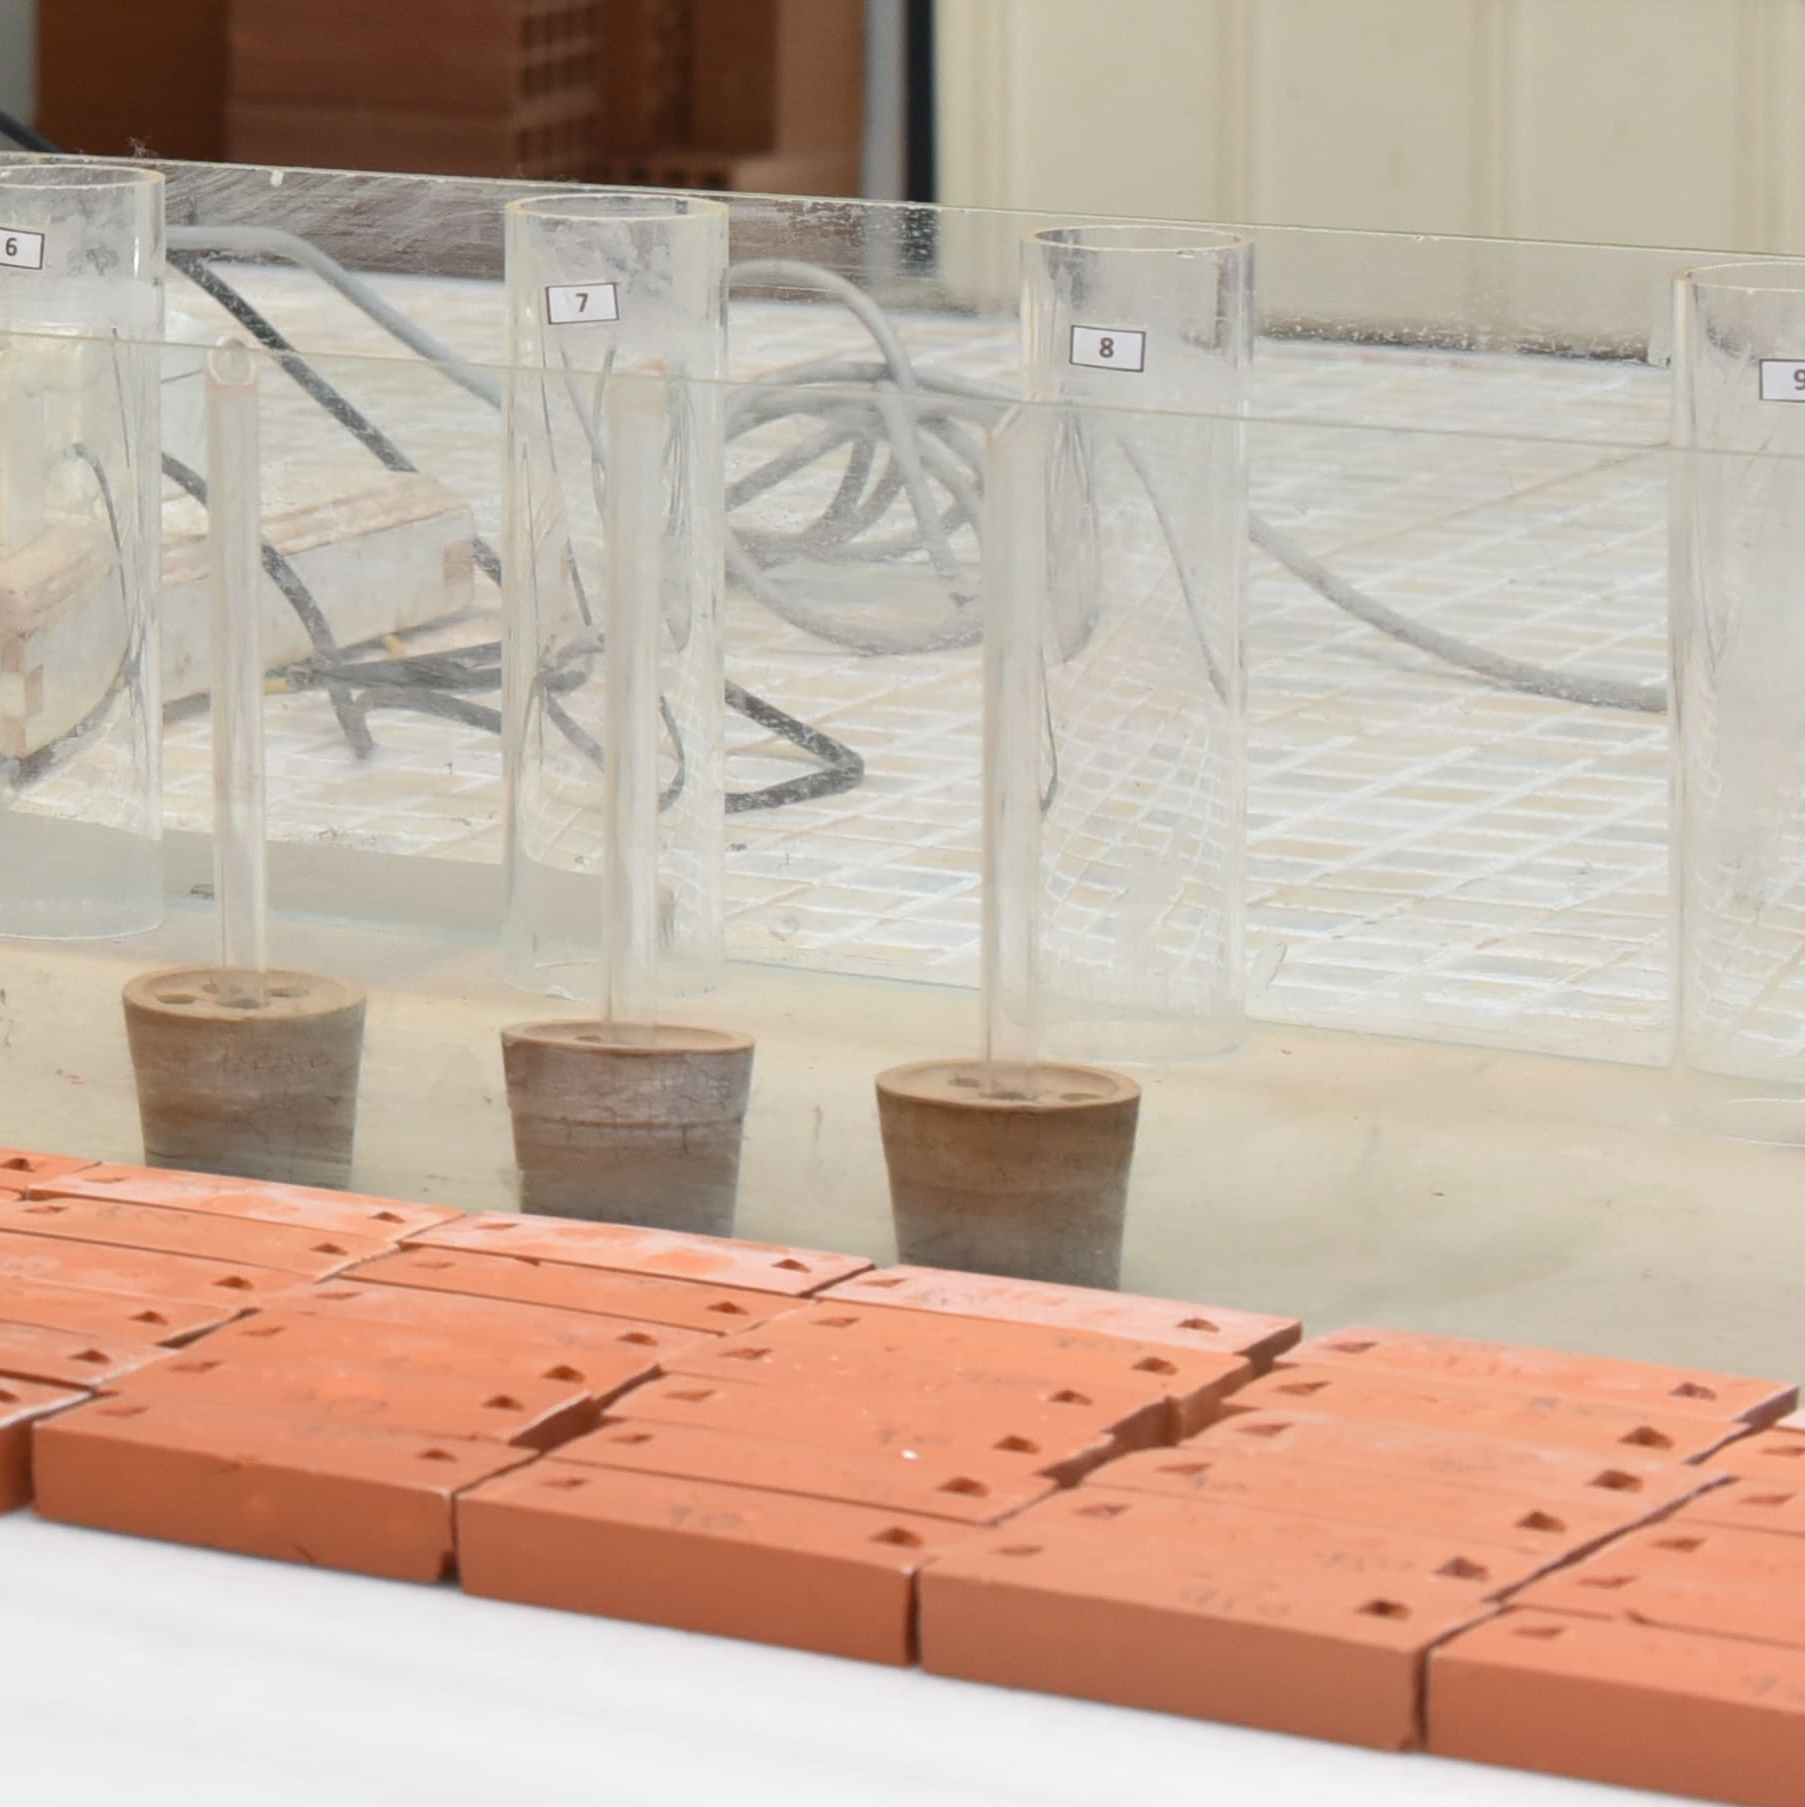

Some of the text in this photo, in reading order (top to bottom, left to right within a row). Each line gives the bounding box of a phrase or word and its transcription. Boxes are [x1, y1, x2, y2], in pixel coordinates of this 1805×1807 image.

[5, 237, 19, 257] 6
[575, 293, 588, 313] 7
[1098, 337, 1115, 359] 8
